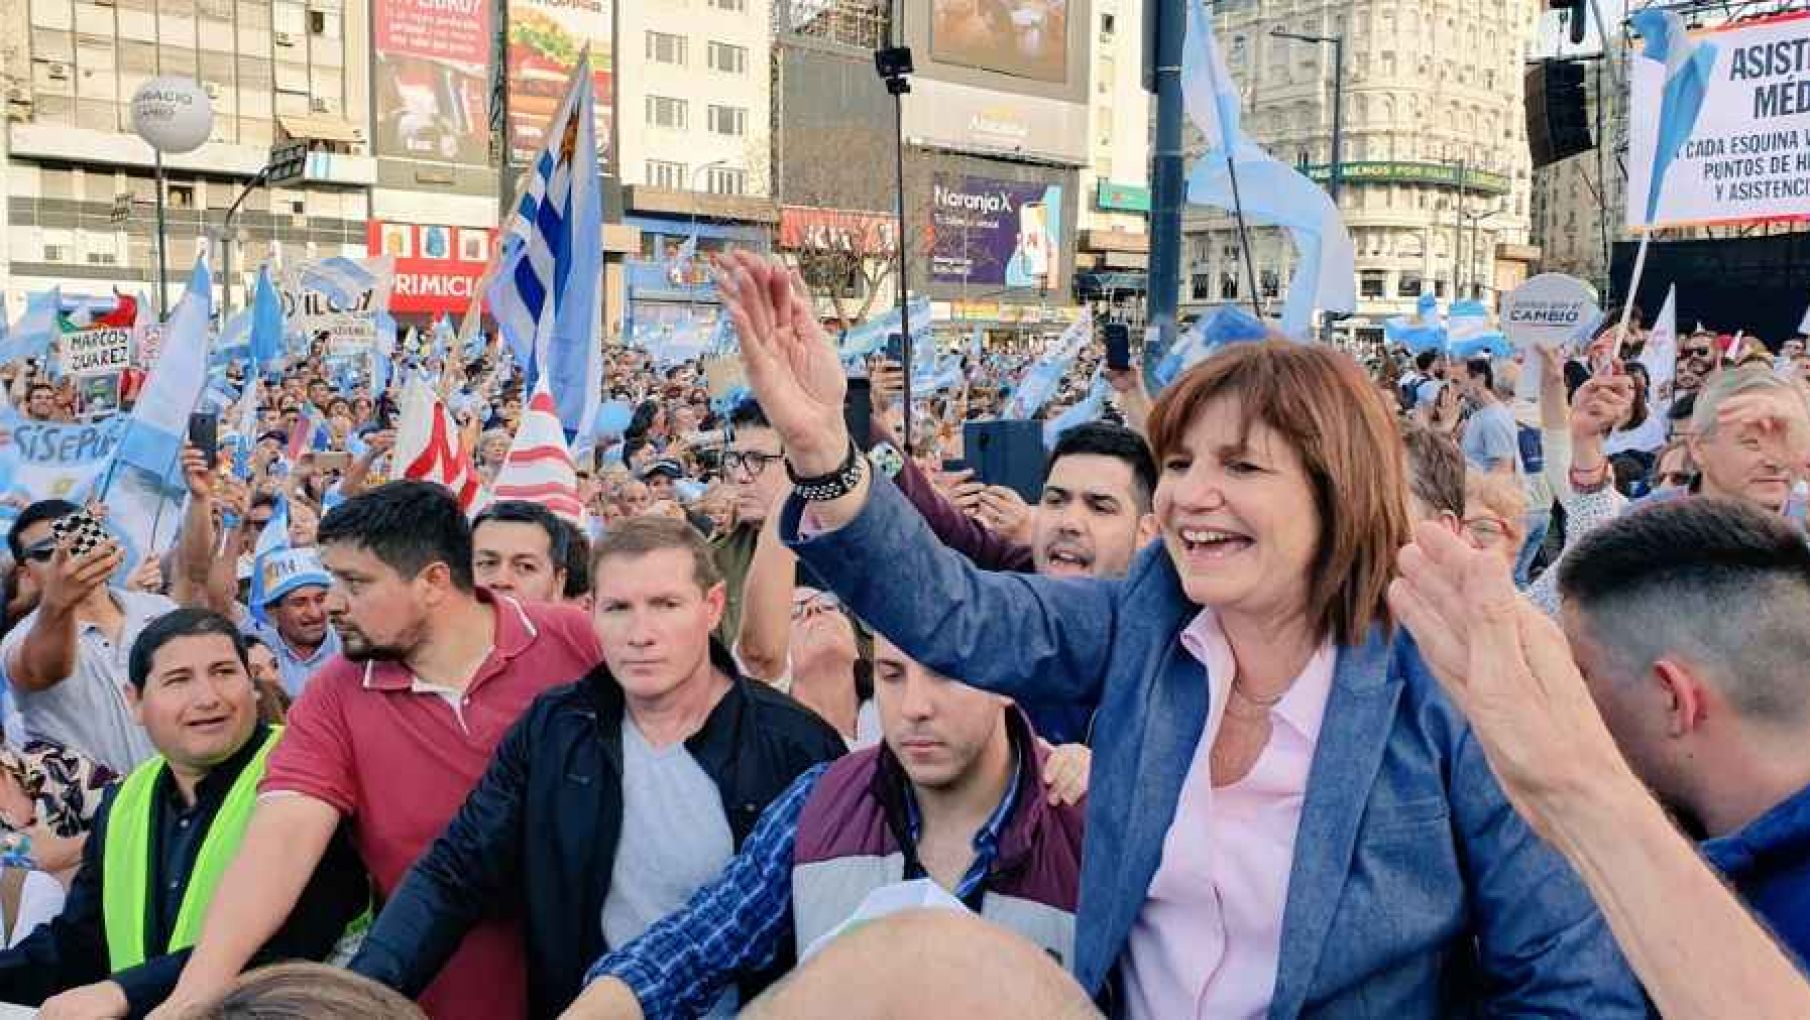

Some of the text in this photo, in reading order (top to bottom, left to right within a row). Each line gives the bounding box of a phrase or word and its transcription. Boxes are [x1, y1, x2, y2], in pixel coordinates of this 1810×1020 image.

[1729, 37, 1810, 80] ASIST
[1686, 139, 1724, 159] CADA
[1730, 131, 1798, 154] ESQUINA
[1704, 158, 1765, 181] PUNTOS
[1770, 155, 1791, 174] DE
[1714, 183, 1724, 203] Y
[391, 272, 482, 298] RIMICI
[1510, 310, 1579, 322] CAMBIO
[71, 330, 128, 350] MARCOS
